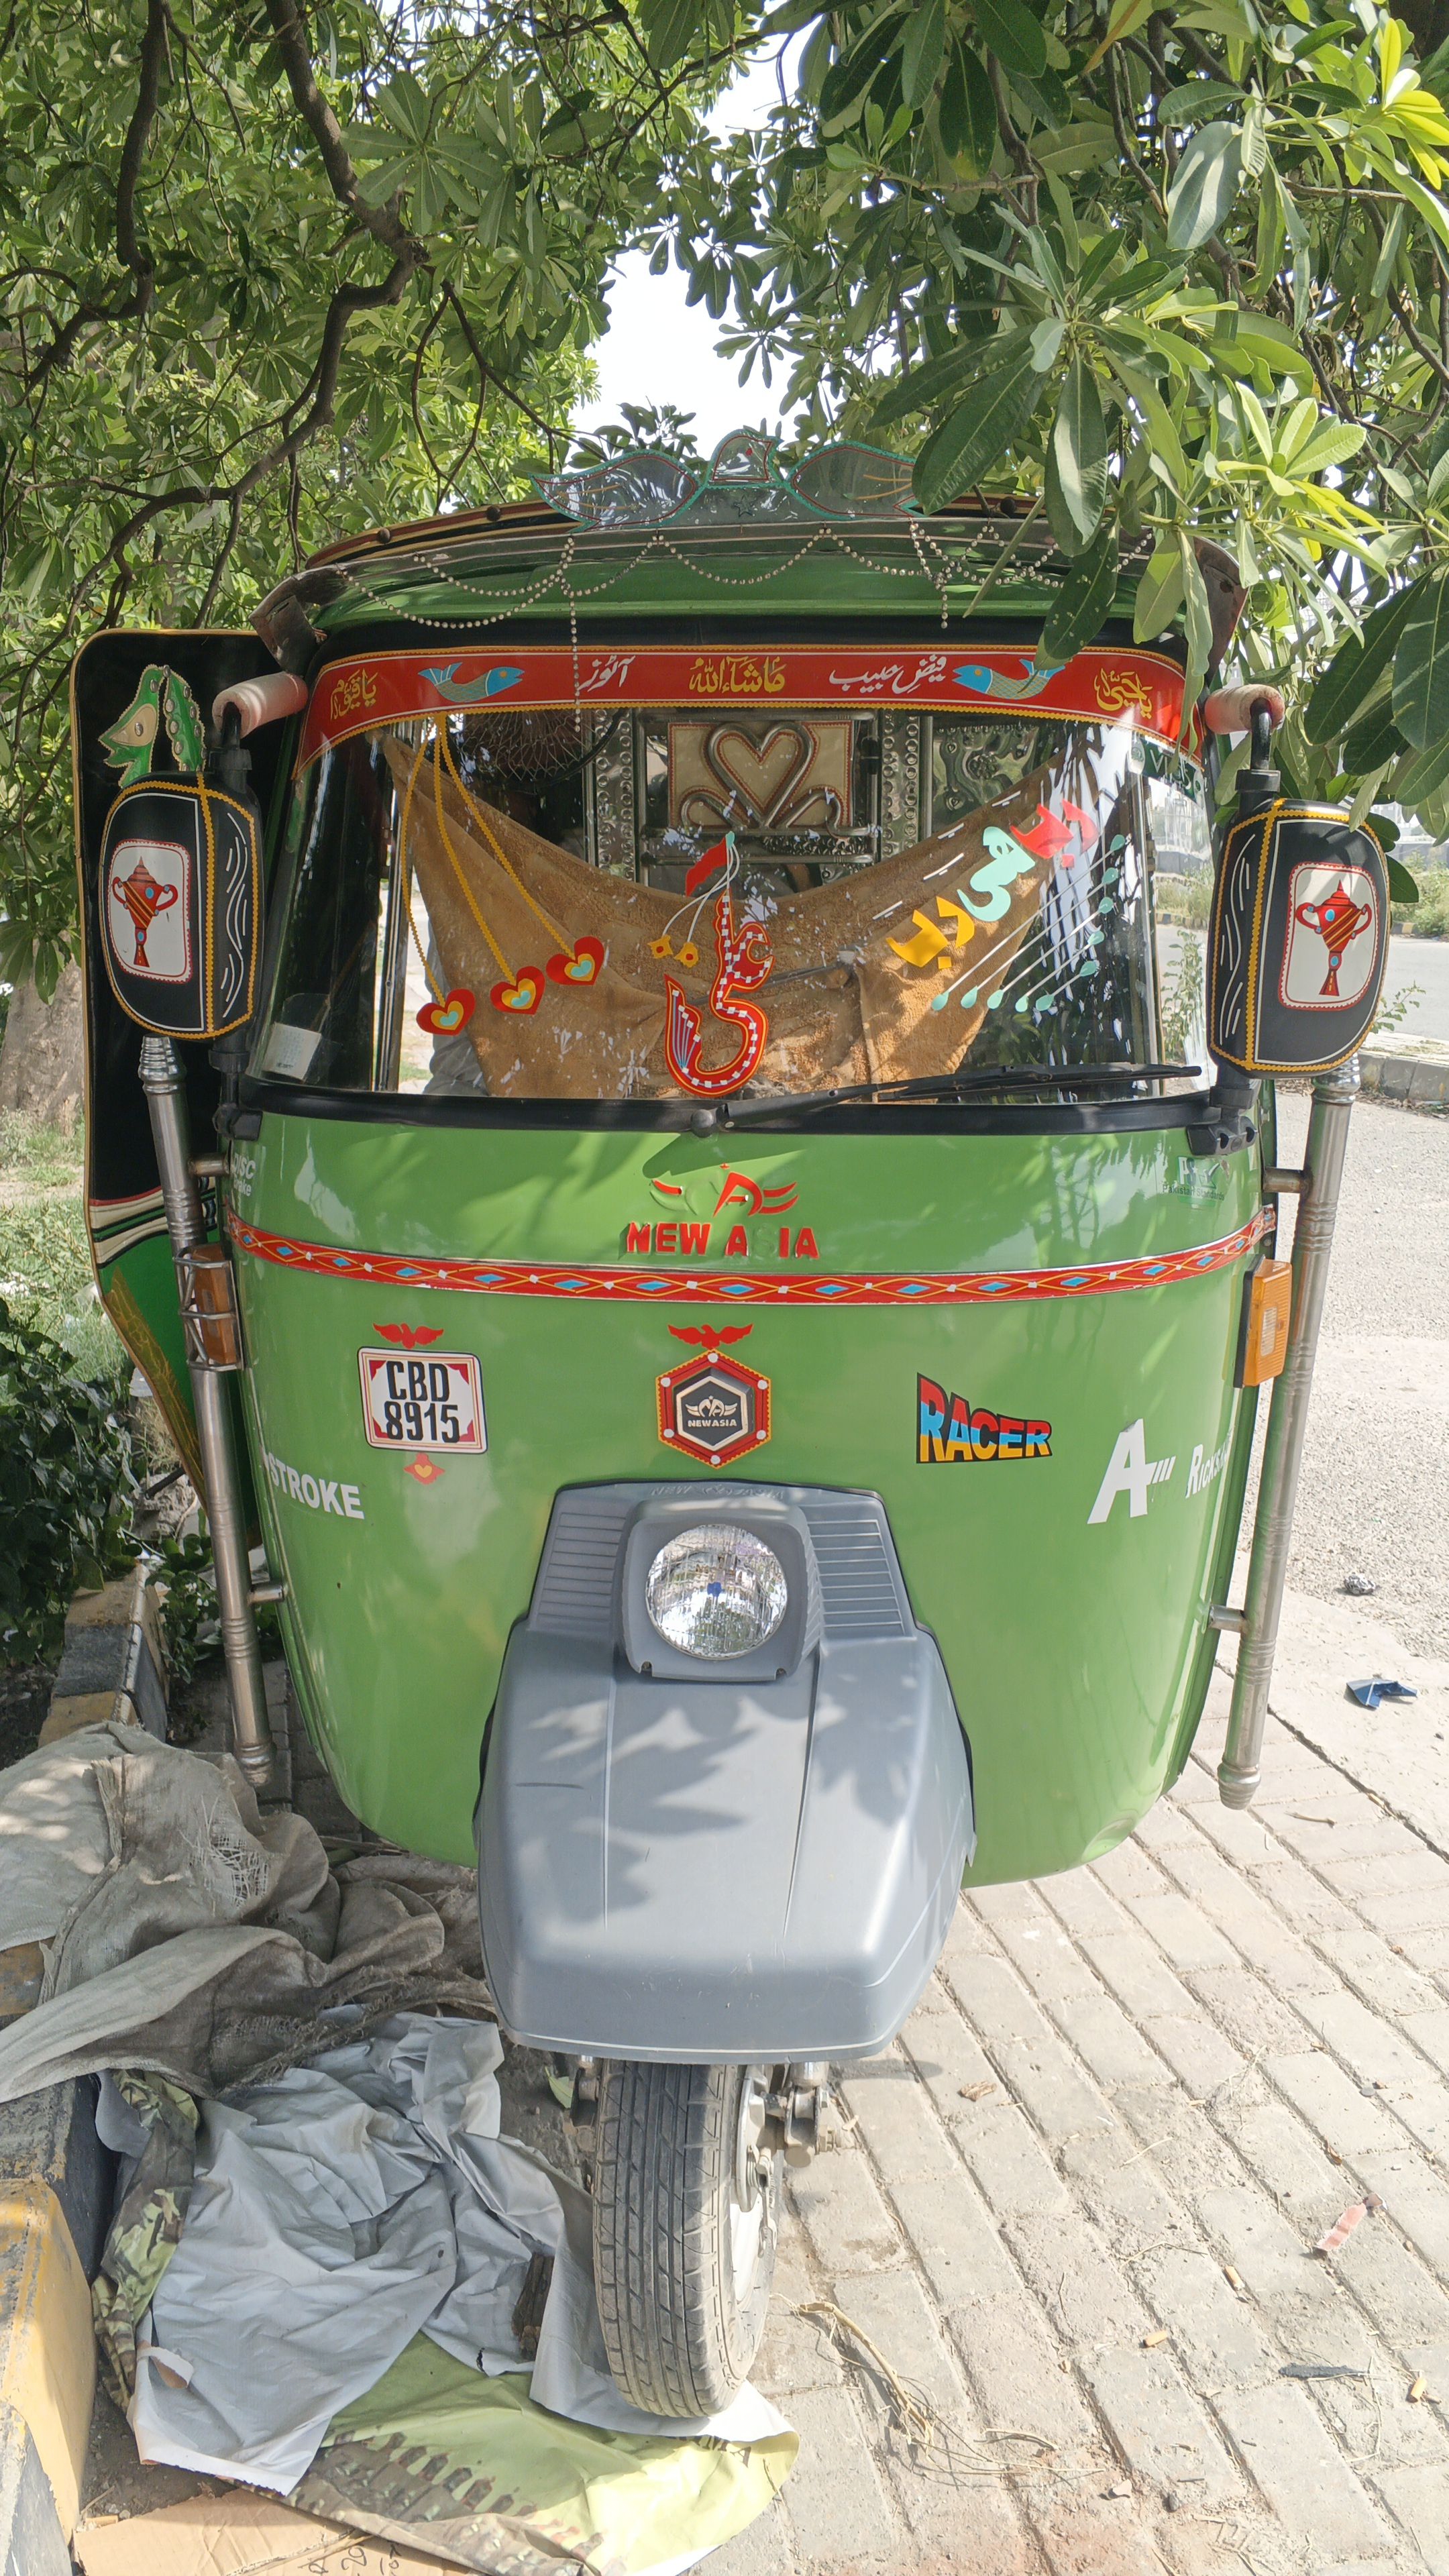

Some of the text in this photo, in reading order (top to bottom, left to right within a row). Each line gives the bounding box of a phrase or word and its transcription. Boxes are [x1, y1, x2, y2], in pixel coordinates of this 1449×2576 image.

[627, 1221, 712, 1256] NEW
[386, 1360, 450, 1402] CBD
[384, 1401, 460, 1444] 8915
[916, 1373, 1052, 1463] RACER
